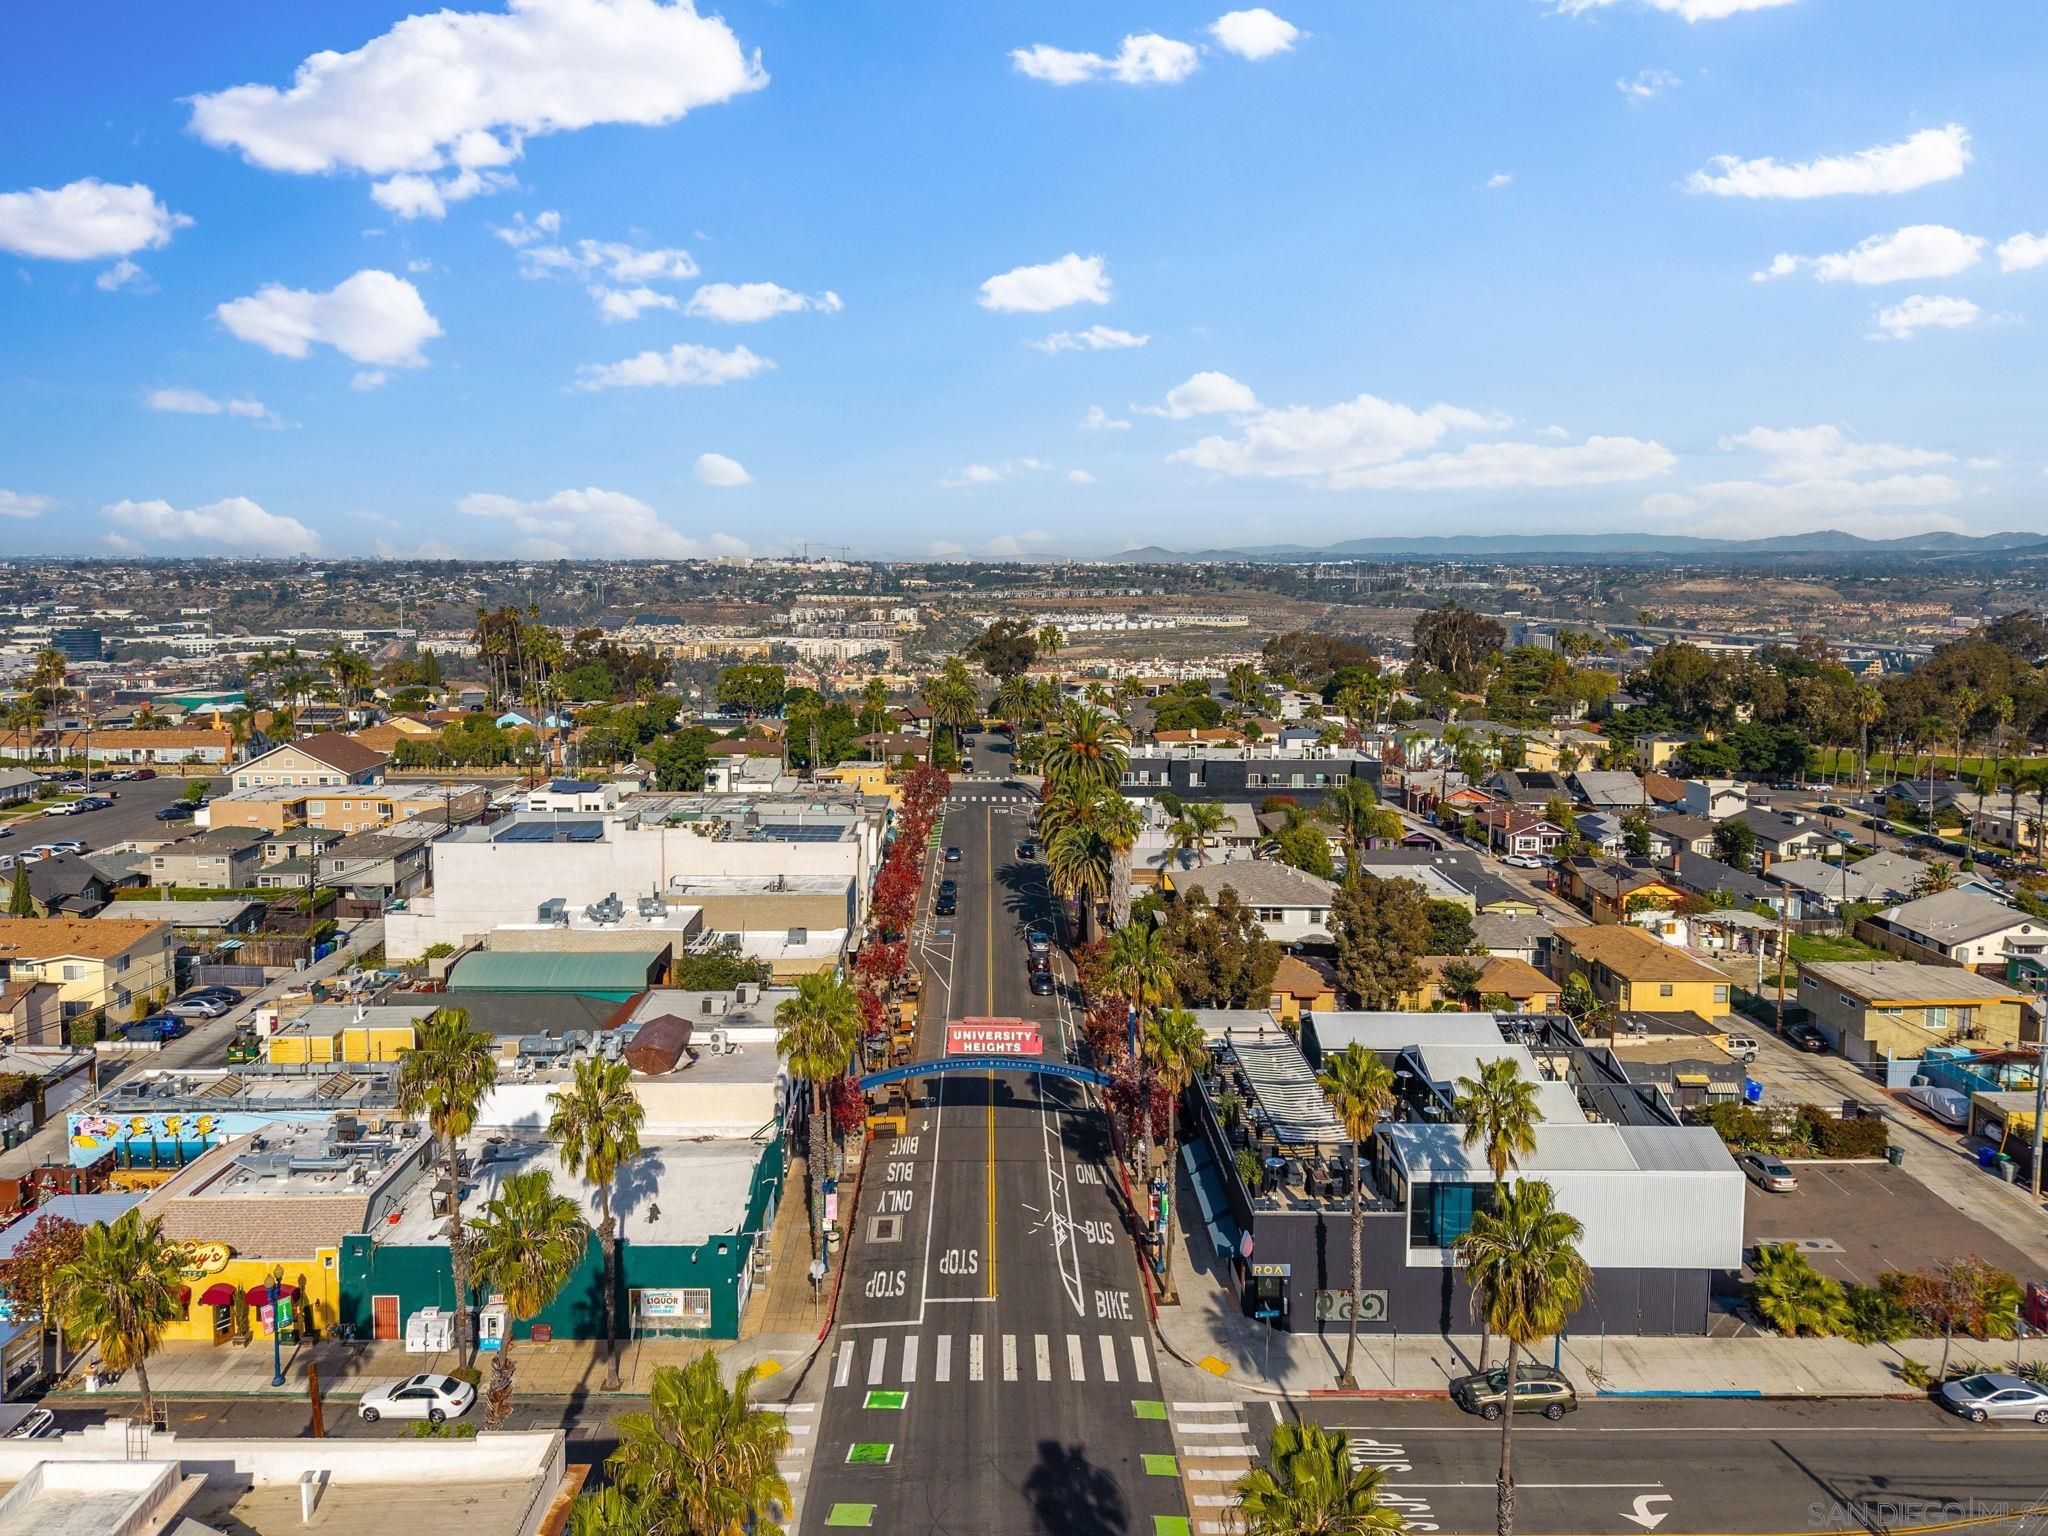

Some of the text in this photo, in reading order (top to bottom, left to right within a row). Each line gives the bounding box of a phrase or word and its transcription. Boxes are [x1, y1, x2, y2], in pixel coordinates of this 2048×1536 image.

[953, 1030, 1032, 1041] UNIVERSITY
[963, 1042, 1021, 1052] HEIGHTS
[904, 1066, 925, 1075] Park
[933, 1061, 981, 1070] Boulevard
[1040, 1064, 1081, 1076] District
[890, 1136, 919, 1155] BIKE
[887, 1162, 914, 1182] BUS
[877, 1190, 913, 1213] ONLY
[1085, 1220, 1115, 1245] BUS
[940, 1249, 978, 1274] STOP
[1254, 1265, 1284, 1275] ROA
[865, 1270, 907, 1298] STOP
[1094, 1290, 1133, 1320] BIKE
